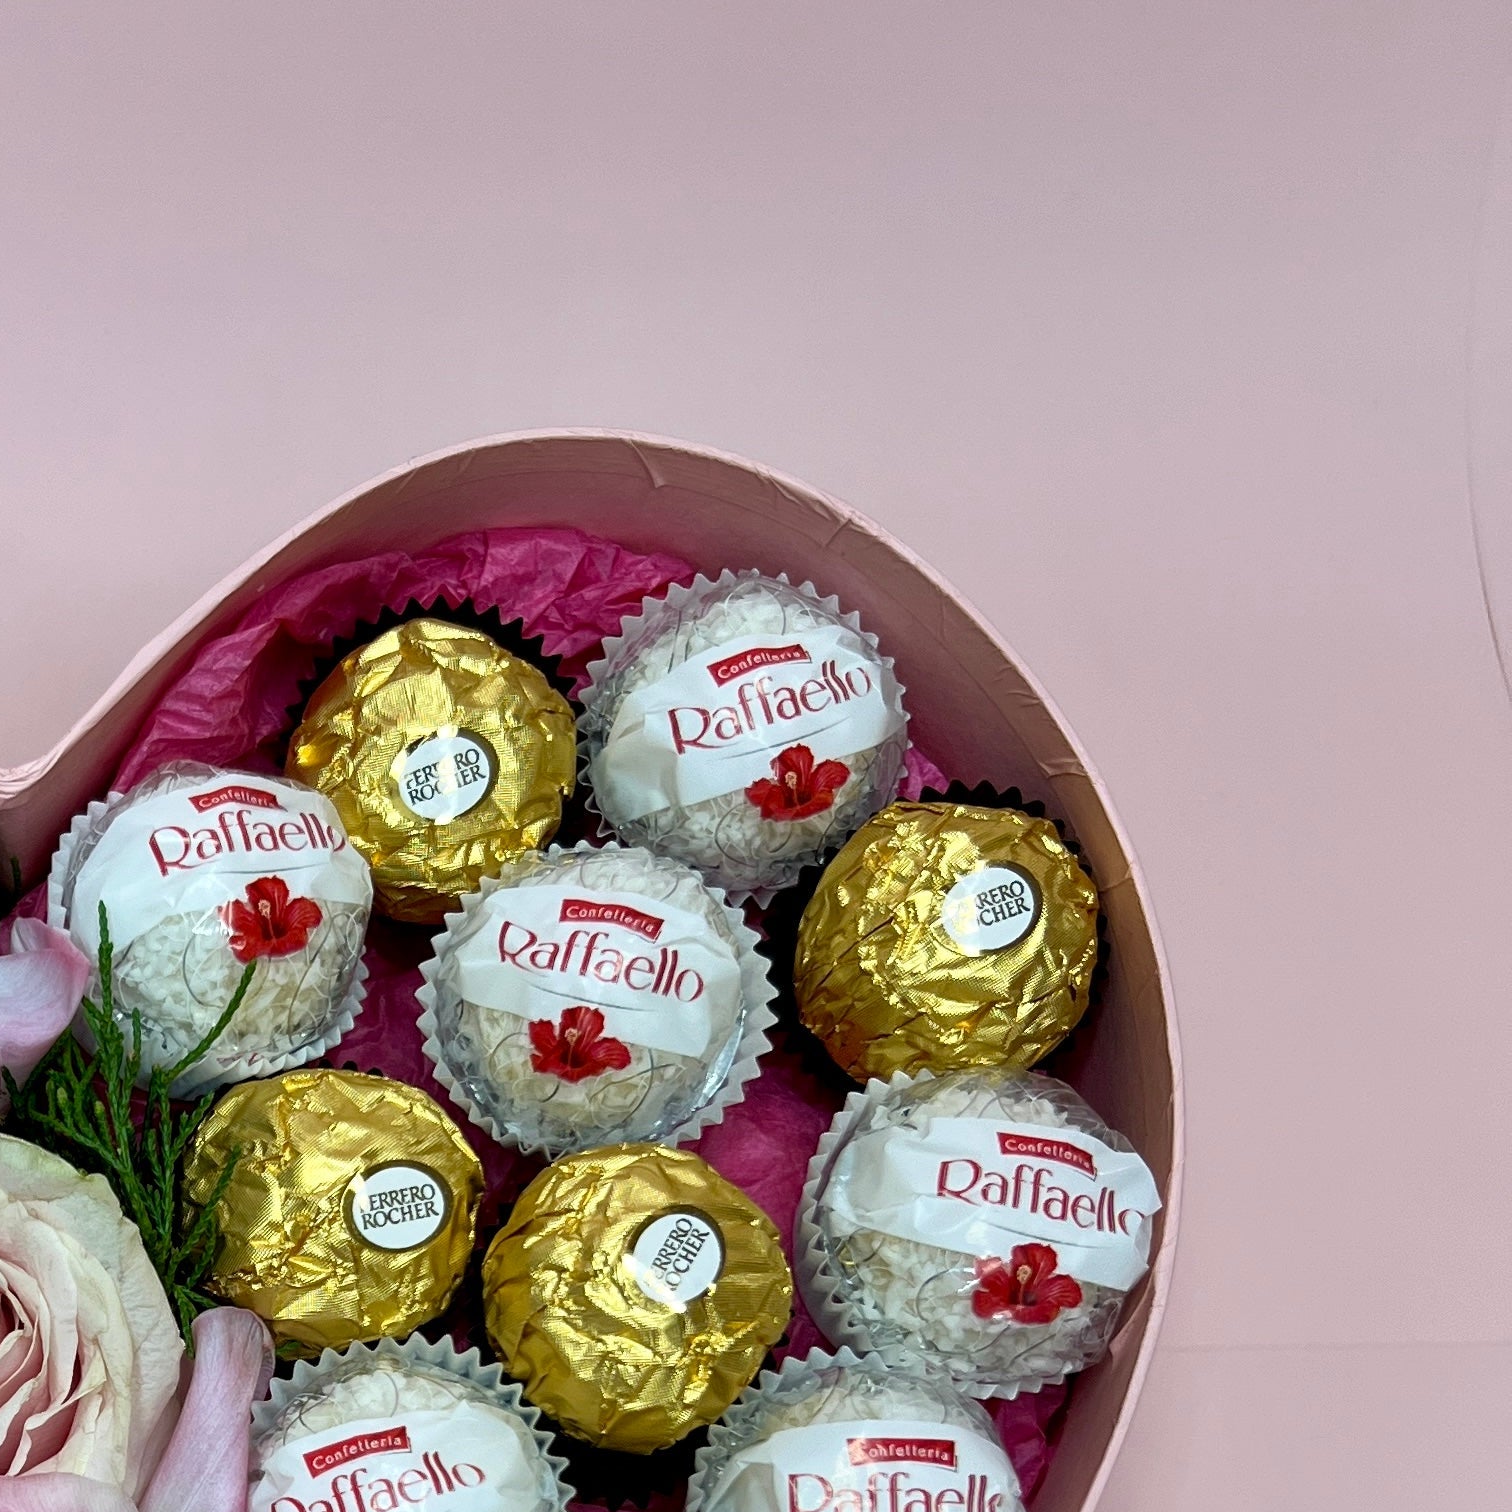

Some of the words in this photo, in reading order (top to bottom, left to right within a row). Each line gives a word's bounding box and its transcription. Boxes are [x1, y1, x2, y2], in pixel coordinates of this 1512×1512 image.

[668, 660, 872, 755] Raffaello
[566, 905, 654, 933] Confetteria
[498, 920, 704, 1002] Raffaello
[360, 1183, 436, 1213] ERRERO
[361, 1201, 439, 1230] ROCHER
[665, 1228, 710, 1291] OCHER
[312, 1435, 402, 1470] Confetteria
